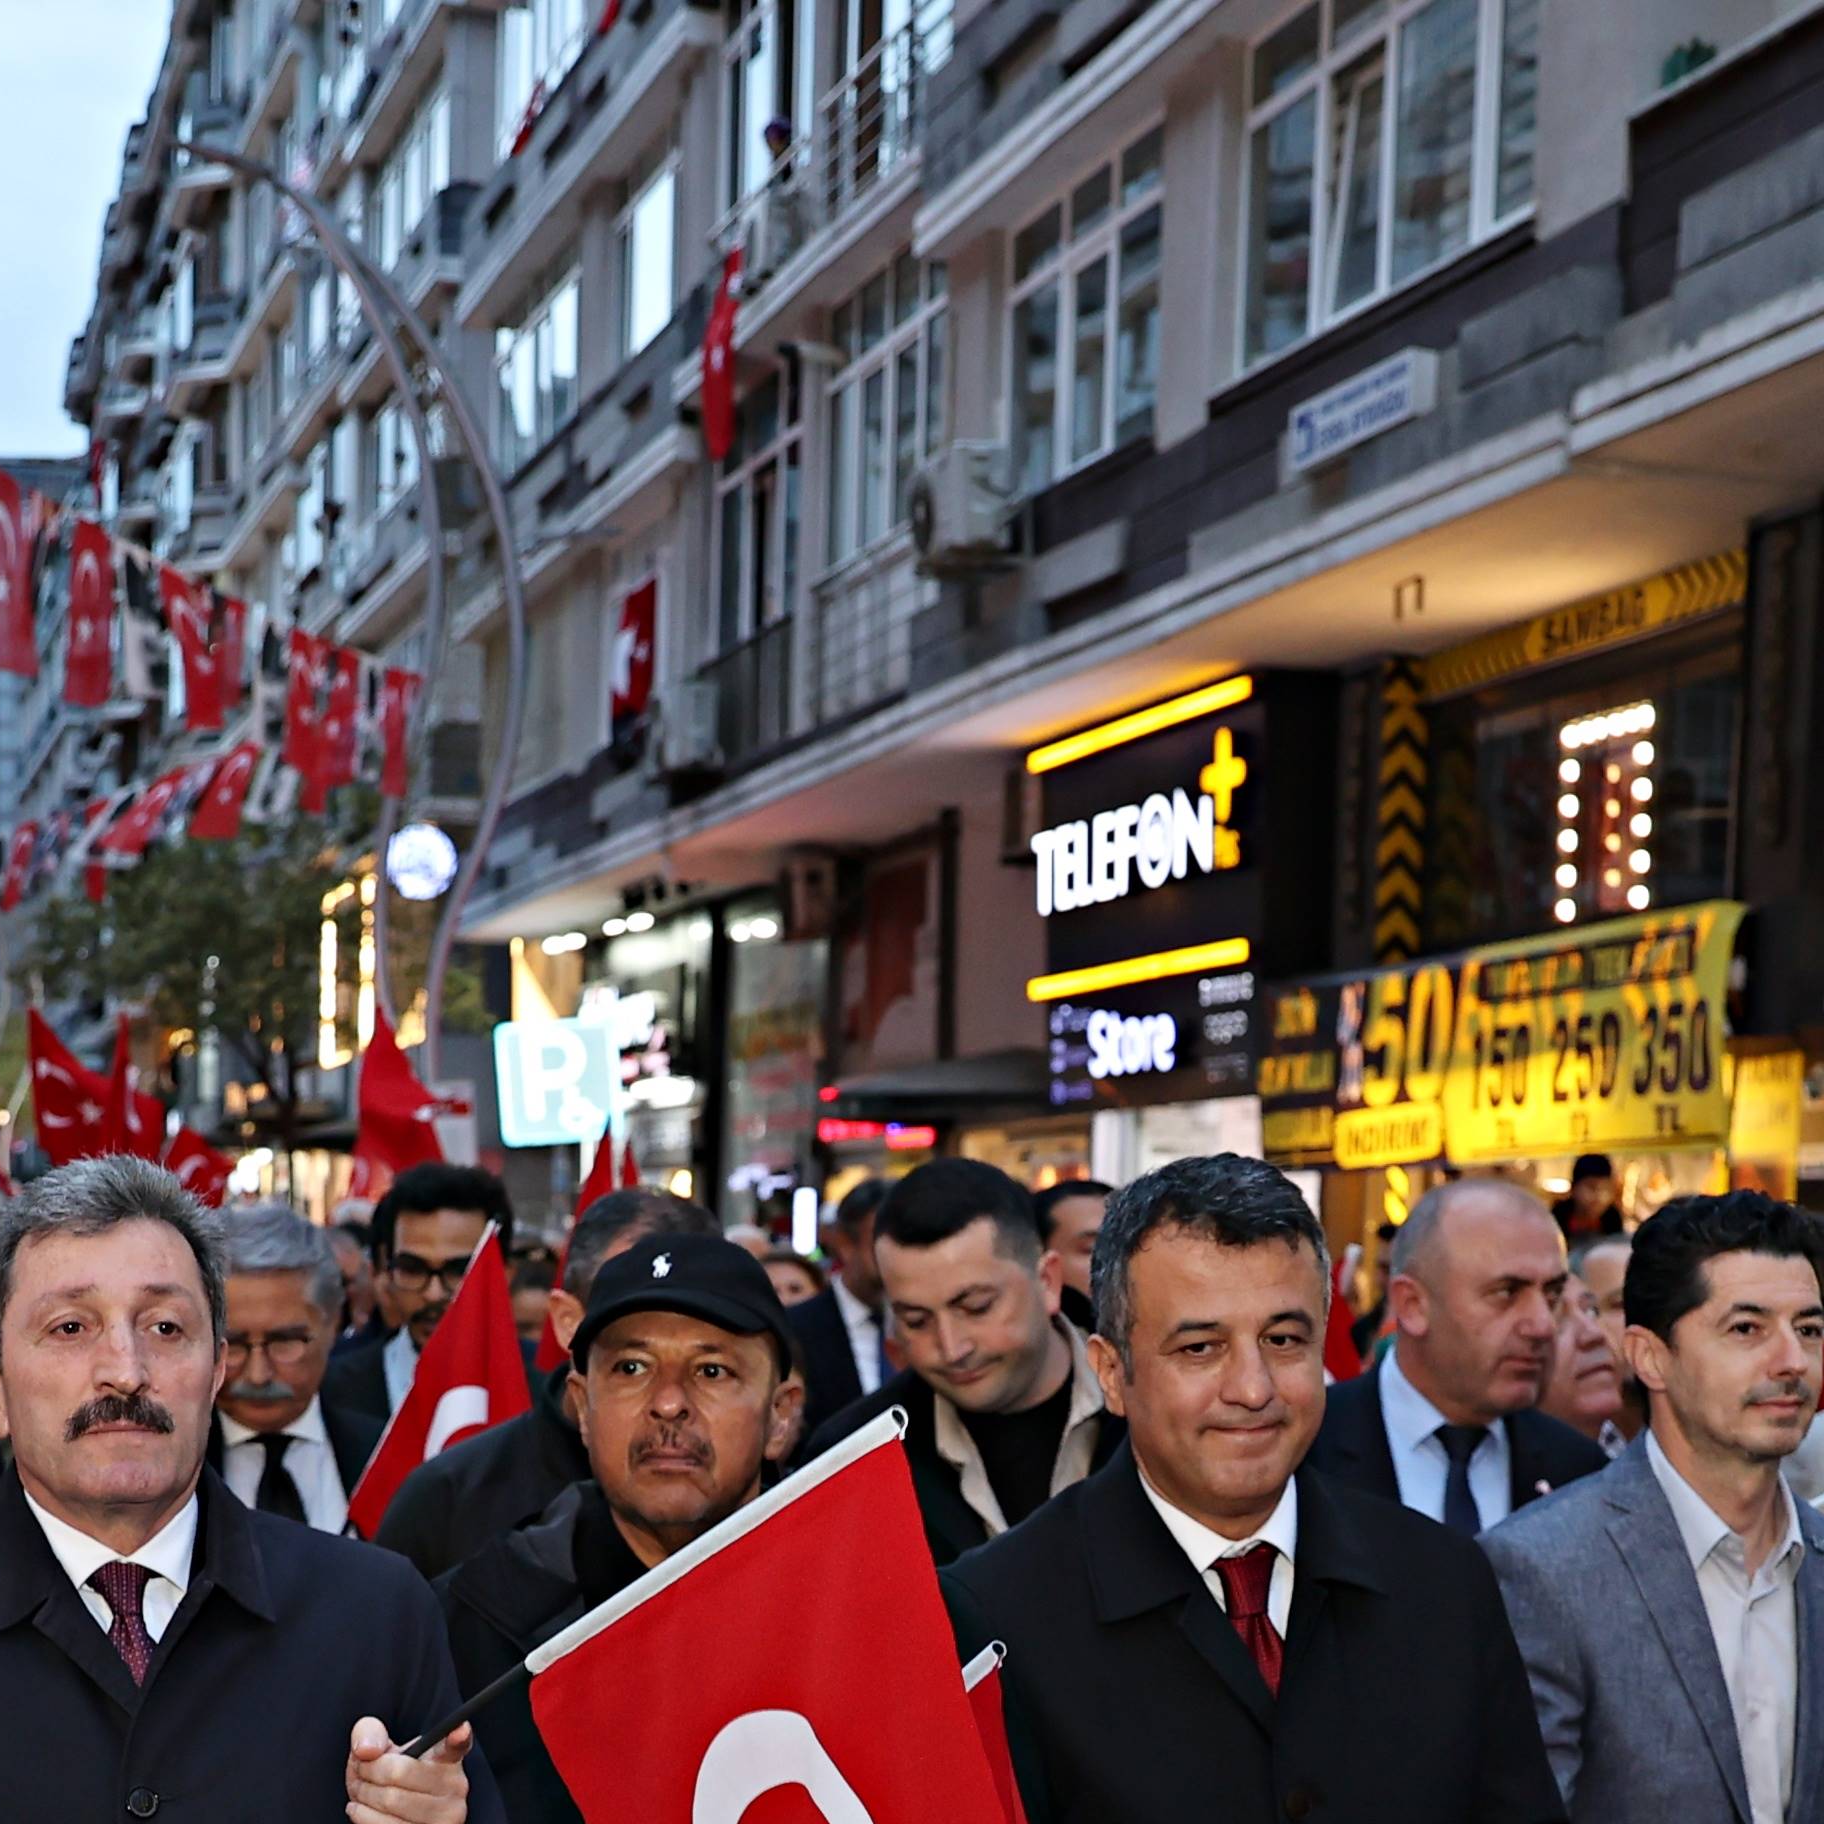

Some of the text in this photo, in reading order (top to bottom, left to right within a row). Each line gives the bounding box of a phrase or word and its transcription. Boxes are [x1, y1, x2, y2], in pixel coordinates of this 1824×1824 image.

[1030, 788, 1215, 916] TELEFON
[1550, 1010, 1622, 1102] 250
[1633, 1000, 1711, 1096] 350
